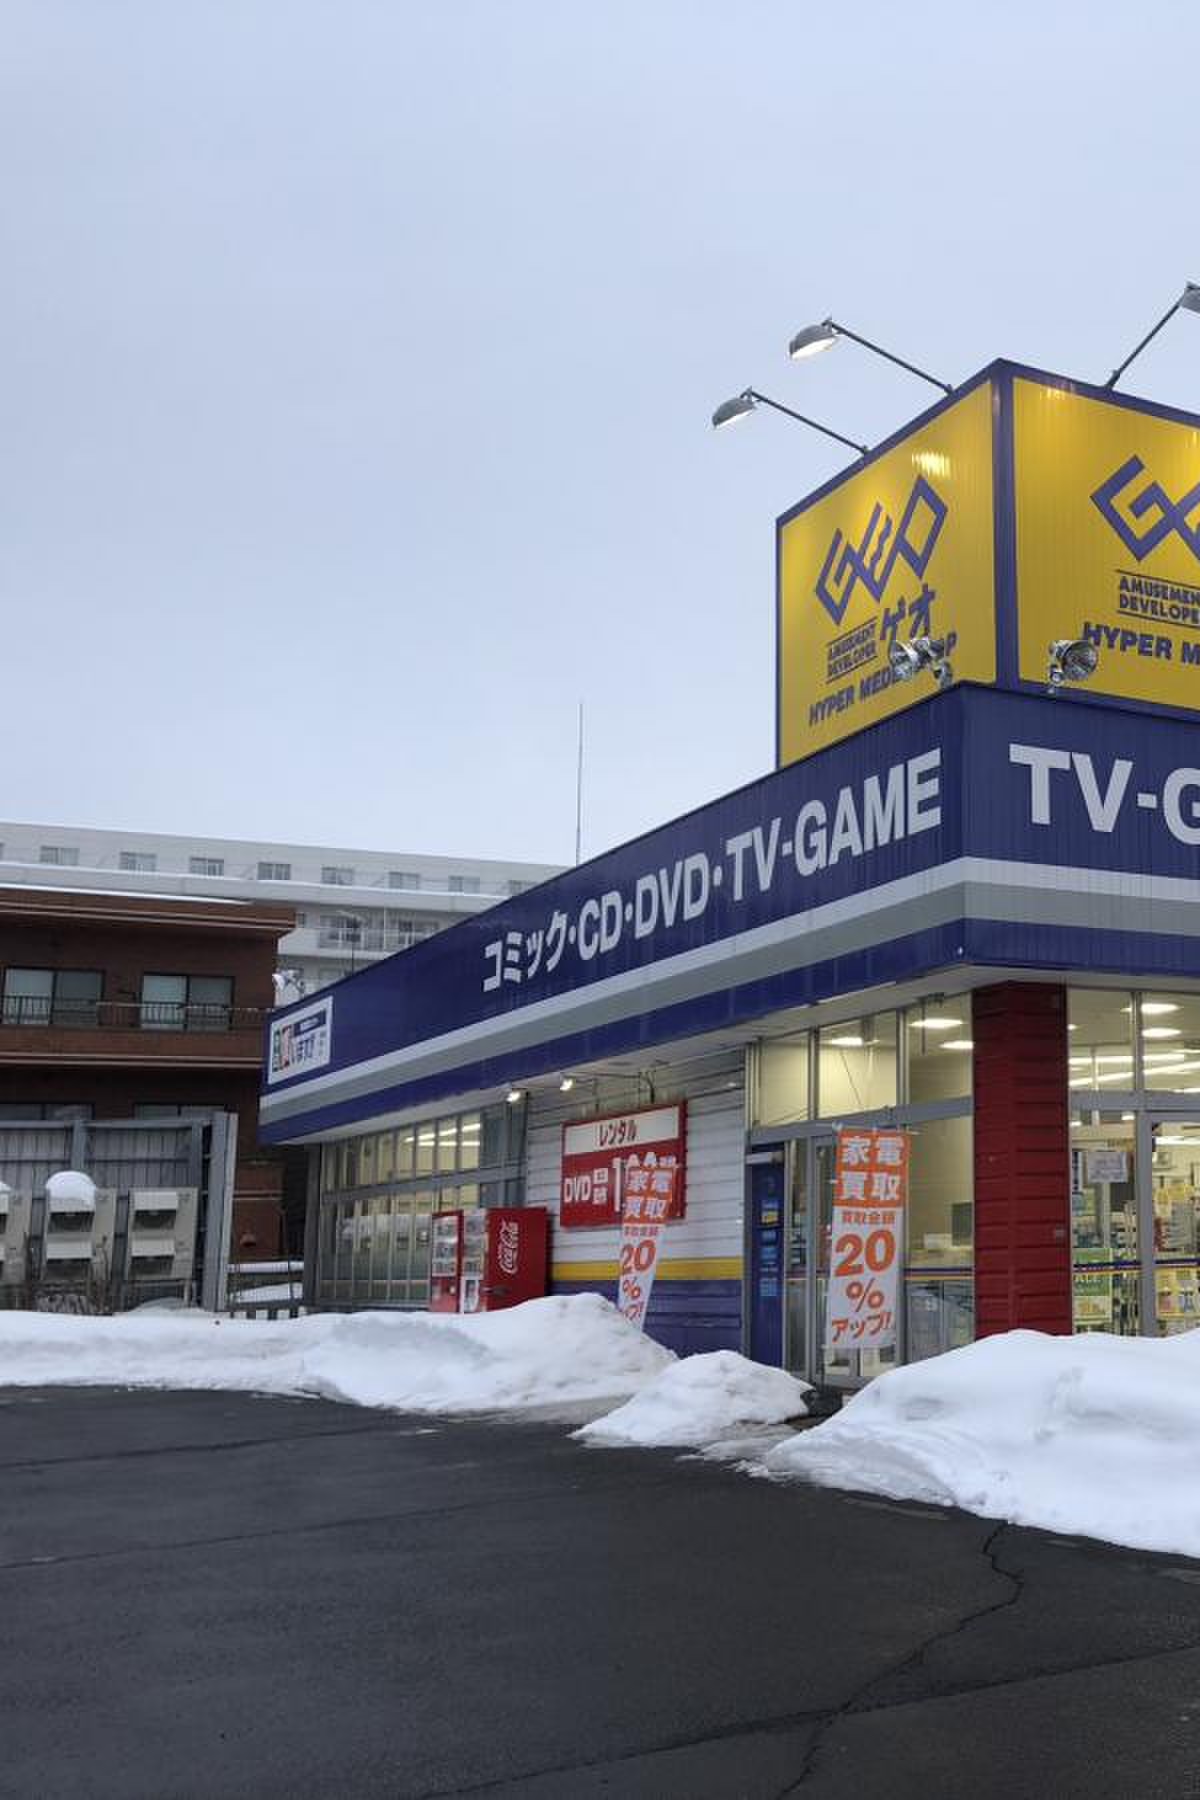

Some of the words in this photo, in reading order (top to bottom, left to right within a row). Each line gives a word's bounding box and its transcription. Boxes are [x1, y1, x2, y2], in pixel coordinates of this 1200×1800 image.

[1083, 621, 1173, 660] HYPER
[809, 685, 855, 727] HYPER
[841, 1136, 905, 1166] 家電
[840, 1171, 901, 1201] 買取
[621, 1240, 657, 1275] 20
[834, 1228, 897, 1278] 20
[846, 1277, 885, 1313] %
